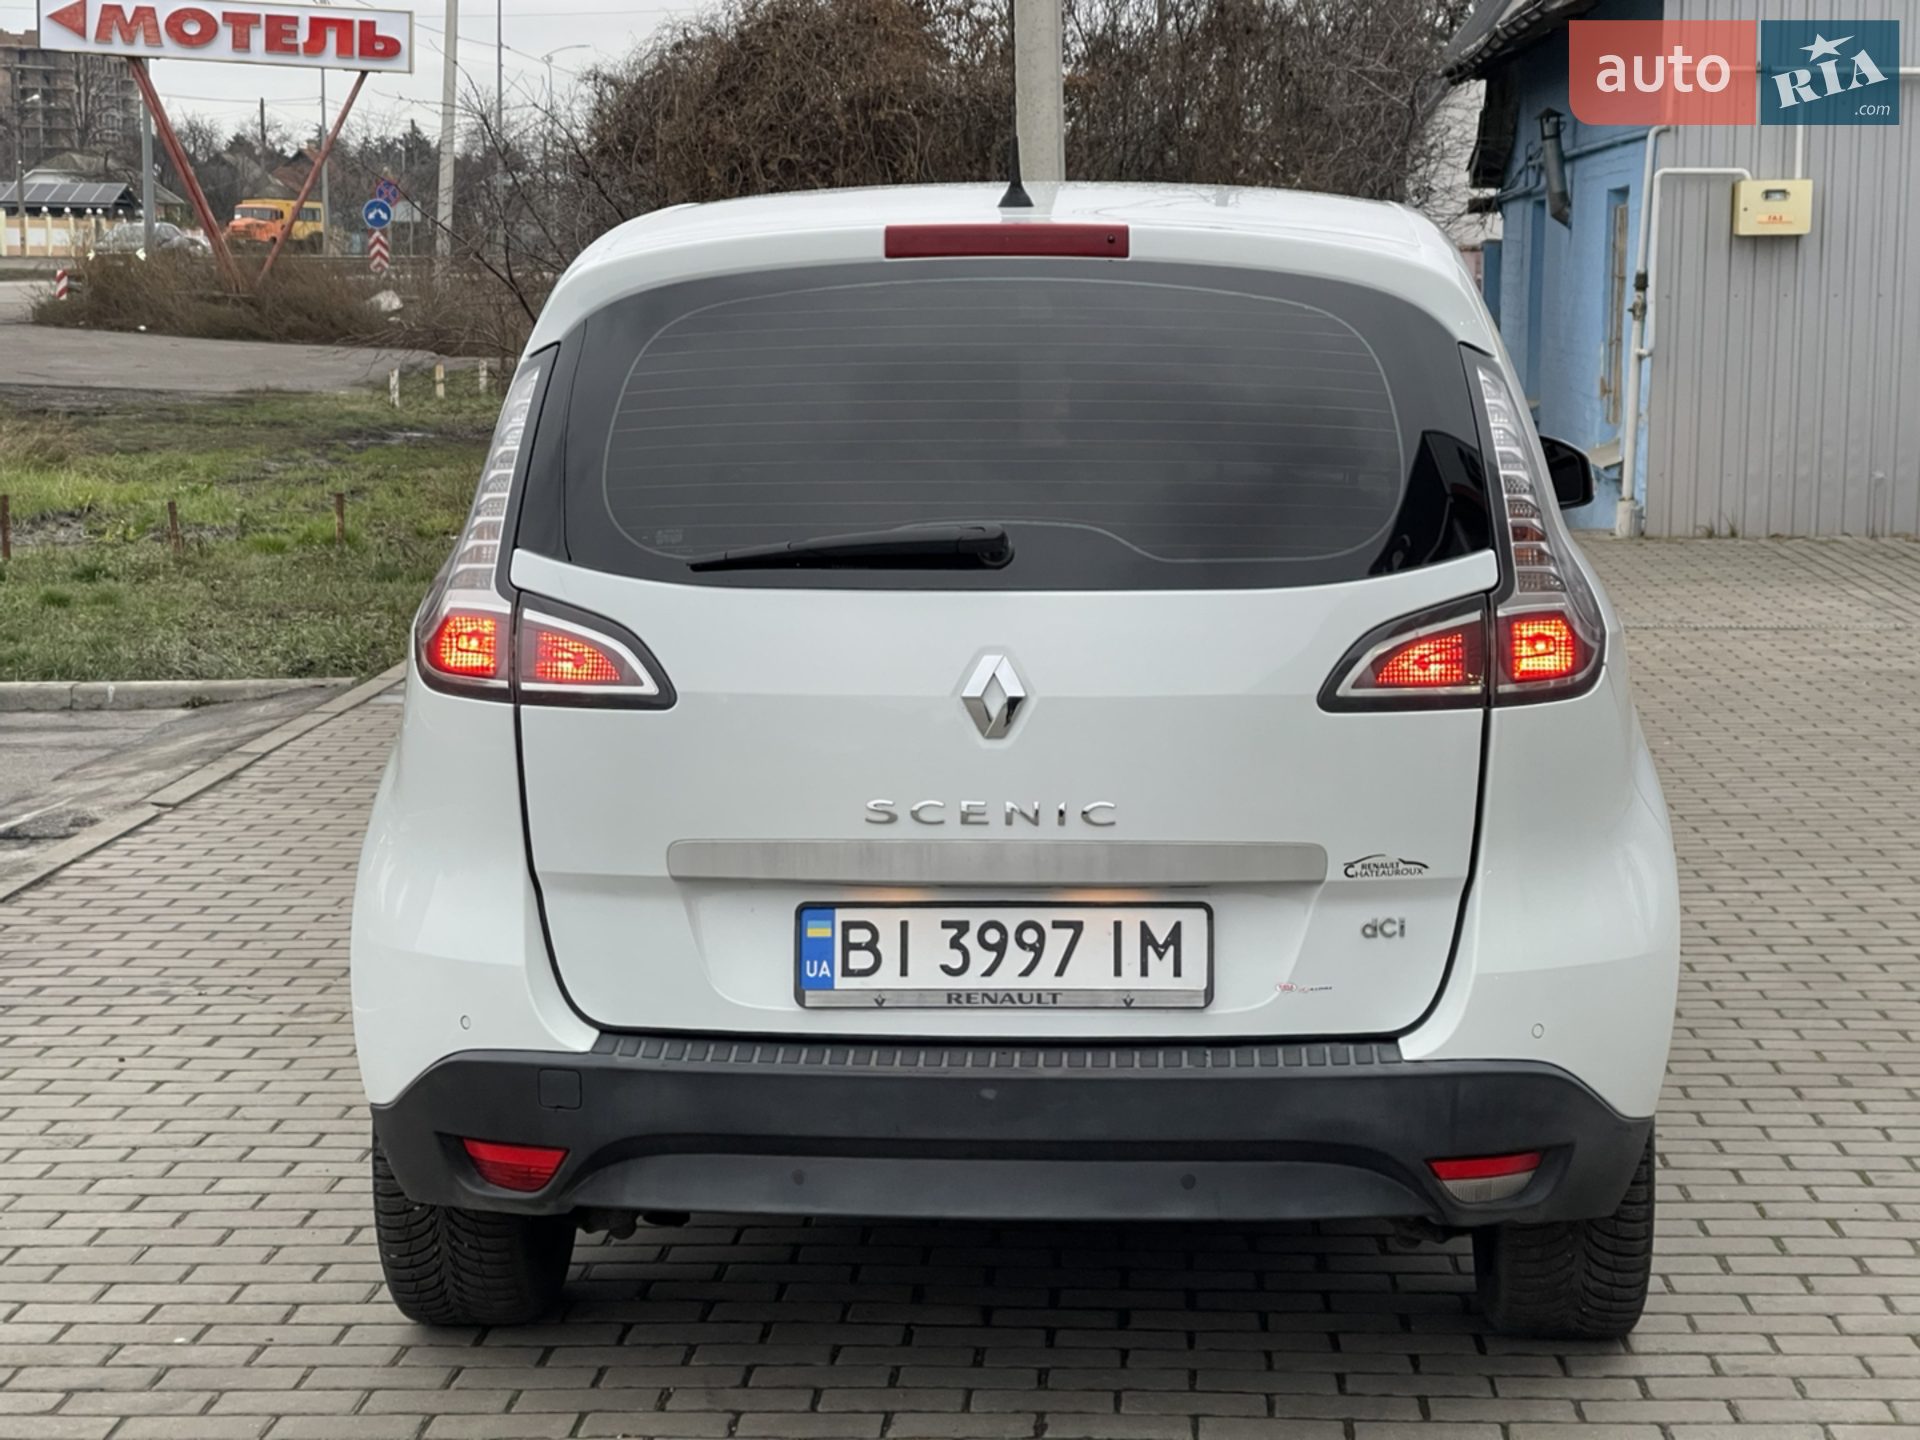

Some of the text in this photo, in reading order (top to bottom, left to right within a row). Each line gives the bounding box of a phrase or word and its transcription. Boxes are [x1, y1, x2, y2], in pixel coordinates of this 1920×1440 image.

[94, 4, 402, 59] МОТЕЛЬ
[864, 799, 1118, 827] SCENIC
[1343, 864, 1424, 878] CHATEAUROUX
[1360, 862, 1400, 870] RENAULT
[1361, 917, 1406, 939] dCi
[840, 919, 1183, 978] BI 3997 IM
[805, 960, 832, 978] UA
[945, 992, 1064, 1005] RENAULT
